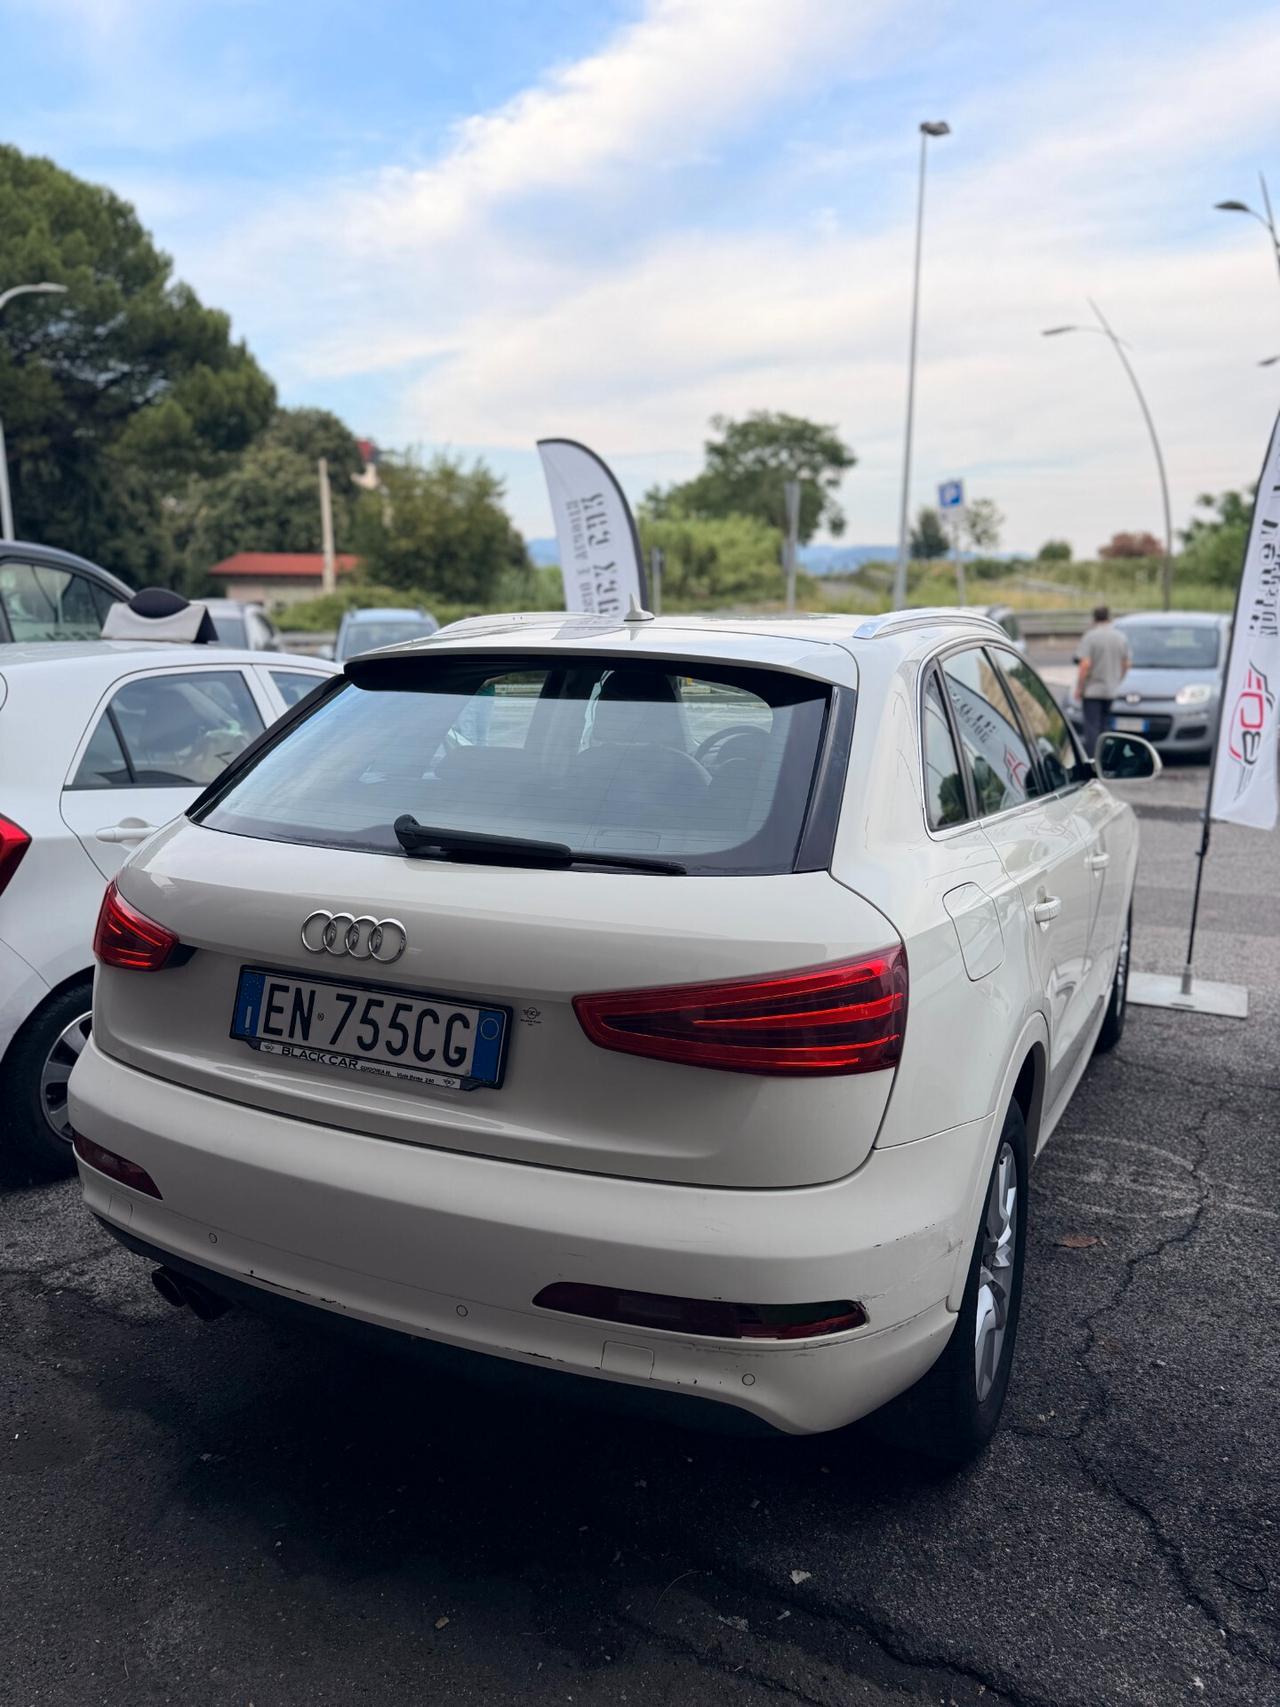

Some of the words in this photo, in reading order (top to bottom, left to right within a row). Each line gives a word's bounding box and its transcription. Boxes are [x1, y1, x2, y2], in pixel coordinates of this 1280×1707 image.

[263, 983, 316, 1041] EN
[329, 993, 471, 1067] 755CG
[282, 1046, 328, 1062] BLACK
[328, 1054, 359, 1071] CAR
